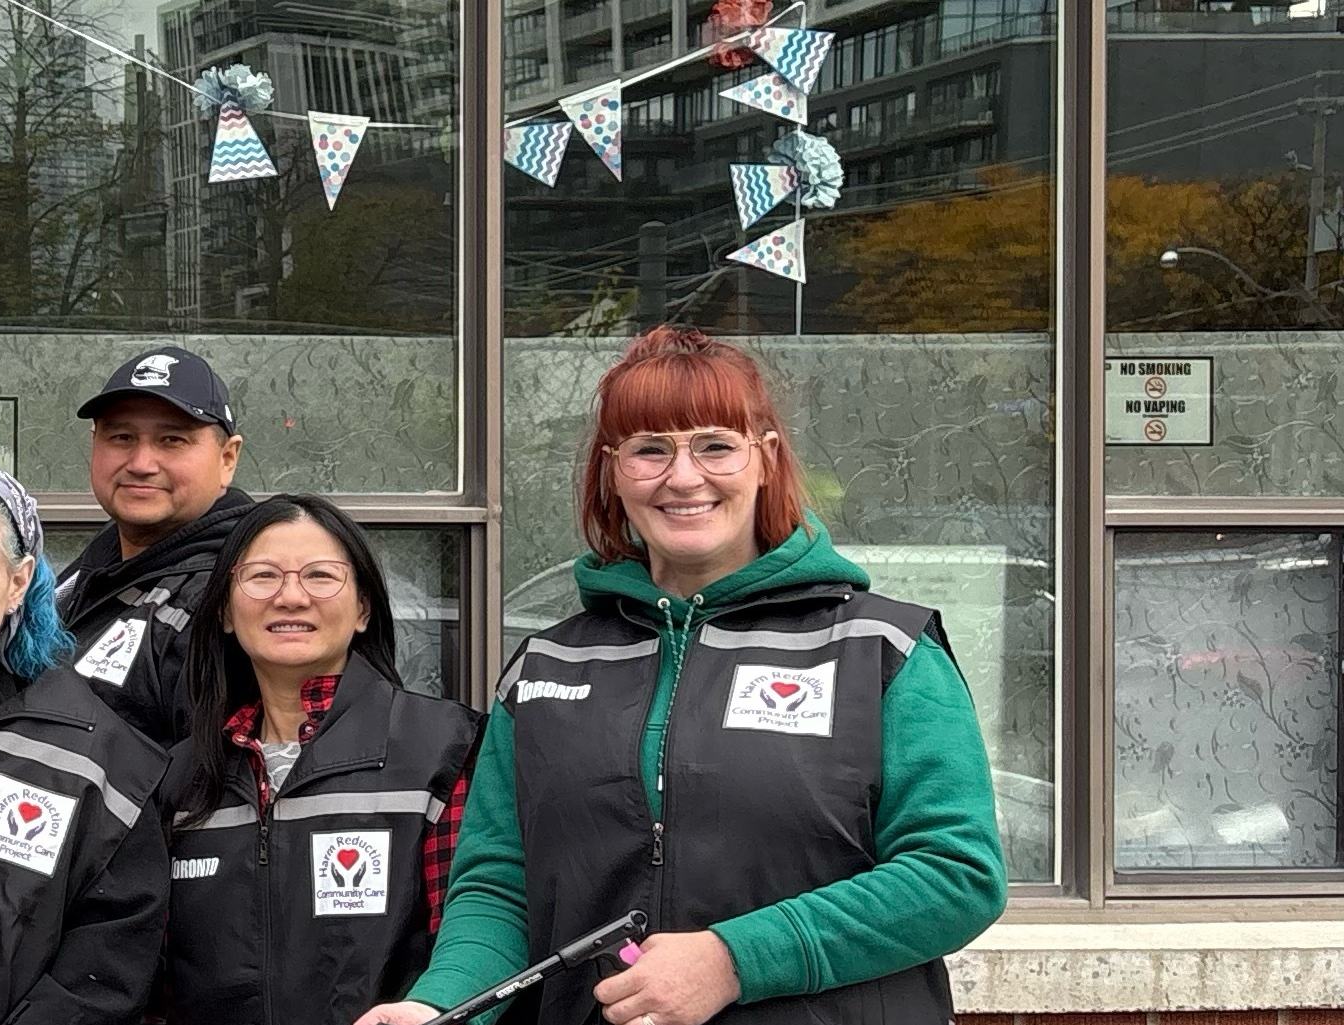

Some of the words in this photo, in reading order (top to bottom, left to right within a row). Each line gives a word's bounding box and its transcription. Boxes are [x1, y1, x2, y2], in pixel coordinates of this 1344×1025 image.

[1120, 363, 1136, 376] NO
[1138, 363, 1192, 376] SMOKING
[1125, 400, 1141, 413] NO
[1144, 400, 1186, 413] VAPING
[516, 679, 592, 704] TORONTO
[738, 675, 769, 699] Harm
[772, 671, 824, 700] Reduction
[801, 710, 827, 719] Care
[22, 788, 62, 837] Reduction
[0, 844, 32, 861] Project
[34, 845, 56, 859] Care
[318, 845, 336, 878] Harm
[336, 835, 382, 875] Reduction
[316, 889, 363, 899] Community
[364, 887, 386, 897] Care
[332, 899, 365, 910] Project
